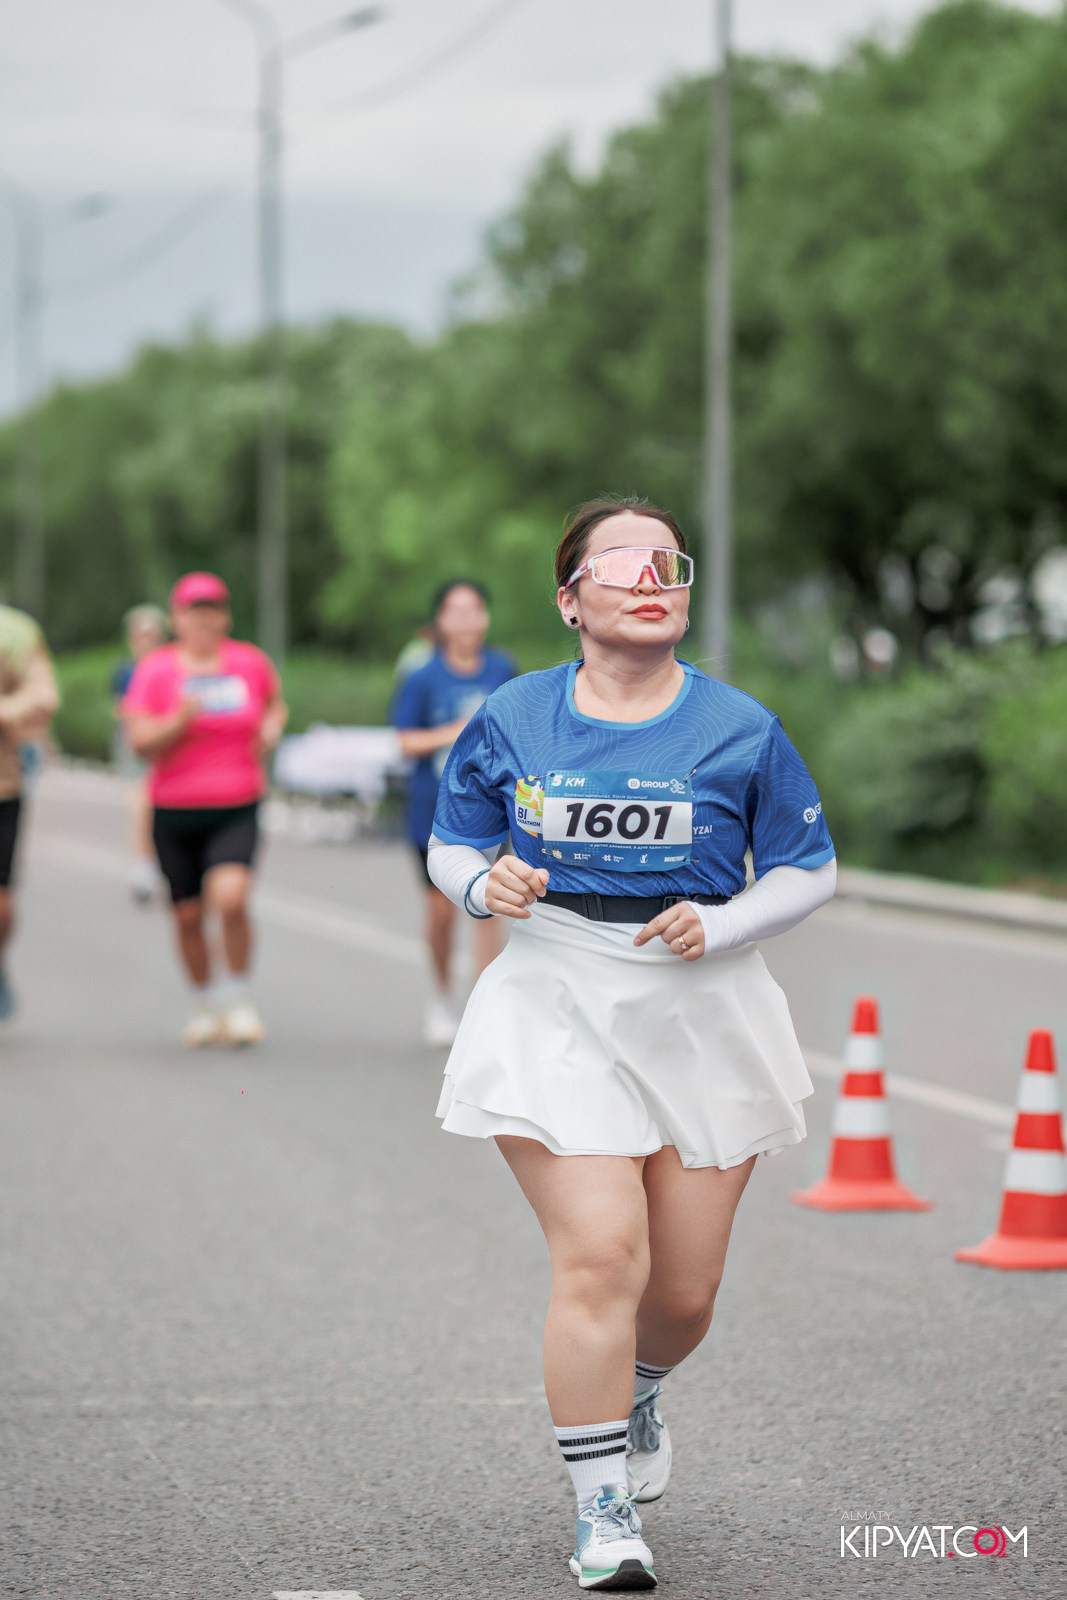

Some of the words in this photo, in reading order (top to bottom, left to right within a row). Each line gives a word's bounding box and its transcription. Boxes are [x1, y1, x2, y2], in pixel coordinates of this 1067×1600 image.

[551, 774, 563, 787] 5
[565, 777, 585, 787] KM
[641, 781, 669, 789] GROUP
[517, 807, 527, 819] BI
[805, 809, 816, 822] BI
[516, 818, 541, 827] MARATHON
[566, 802, 672, 840] 1601
[693, 824, 713, 835] YZAI
